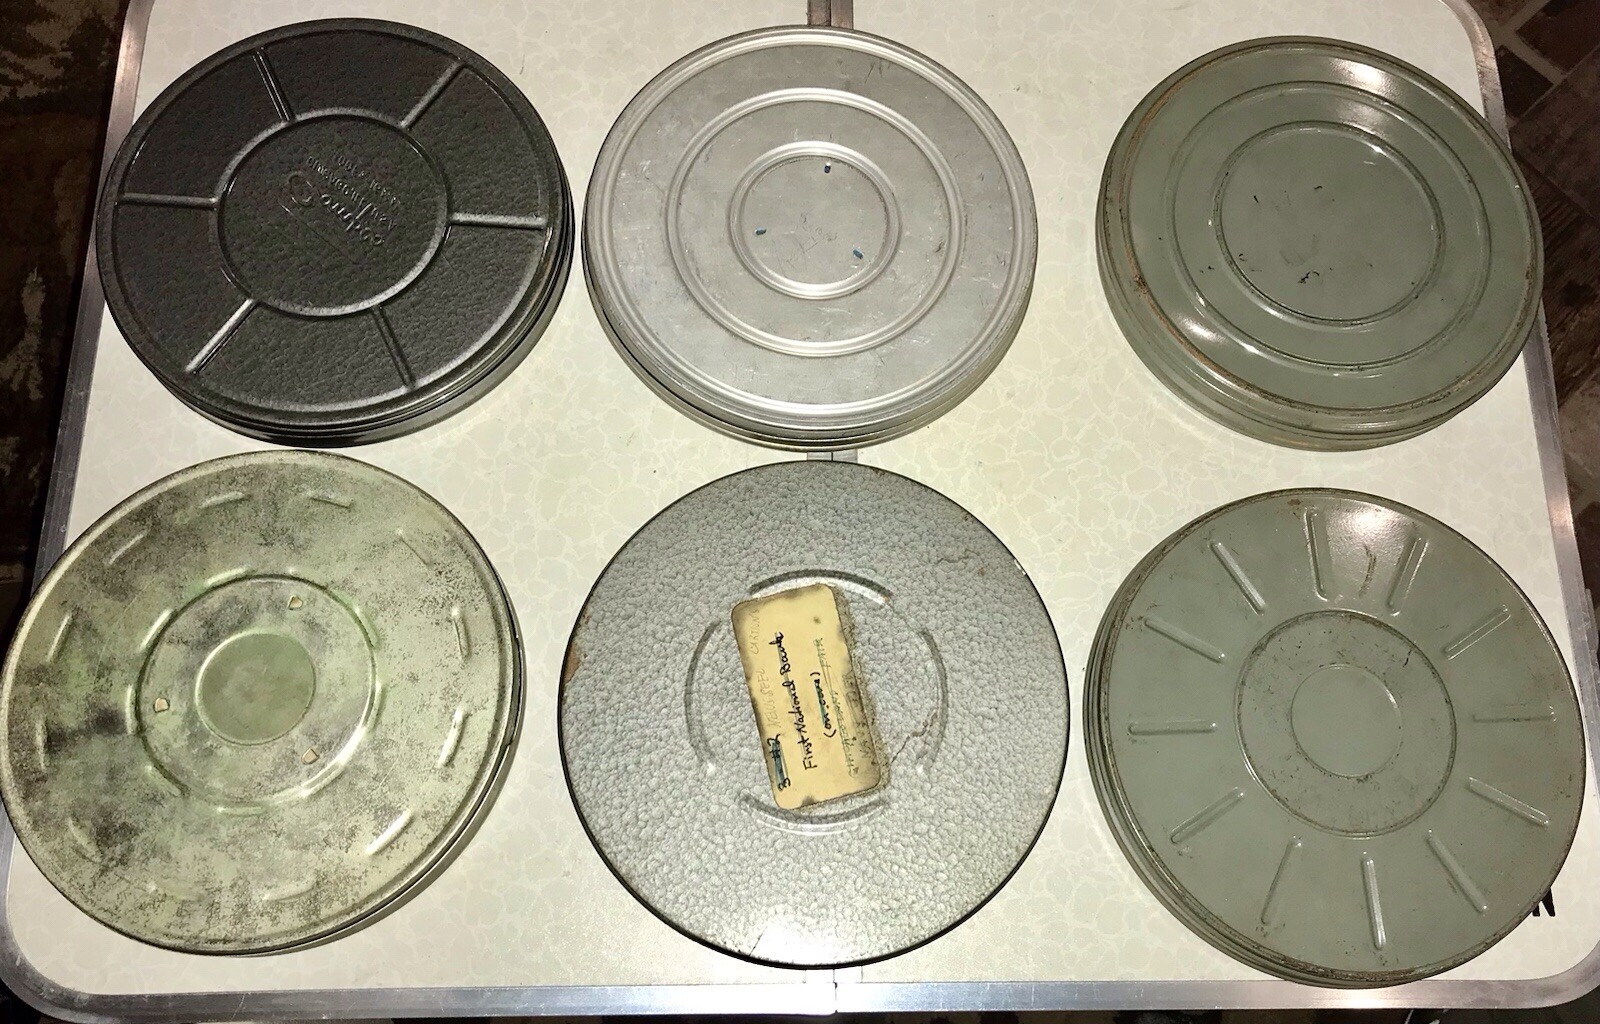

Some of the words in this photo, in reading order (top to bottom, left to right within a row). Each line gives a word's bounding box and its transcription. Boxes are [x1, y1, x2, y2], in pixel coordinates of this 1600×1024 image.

[768, 631, 791, 675] Bank
[781, 680, 807, 735] National
[796, 735, 817, 770] First
